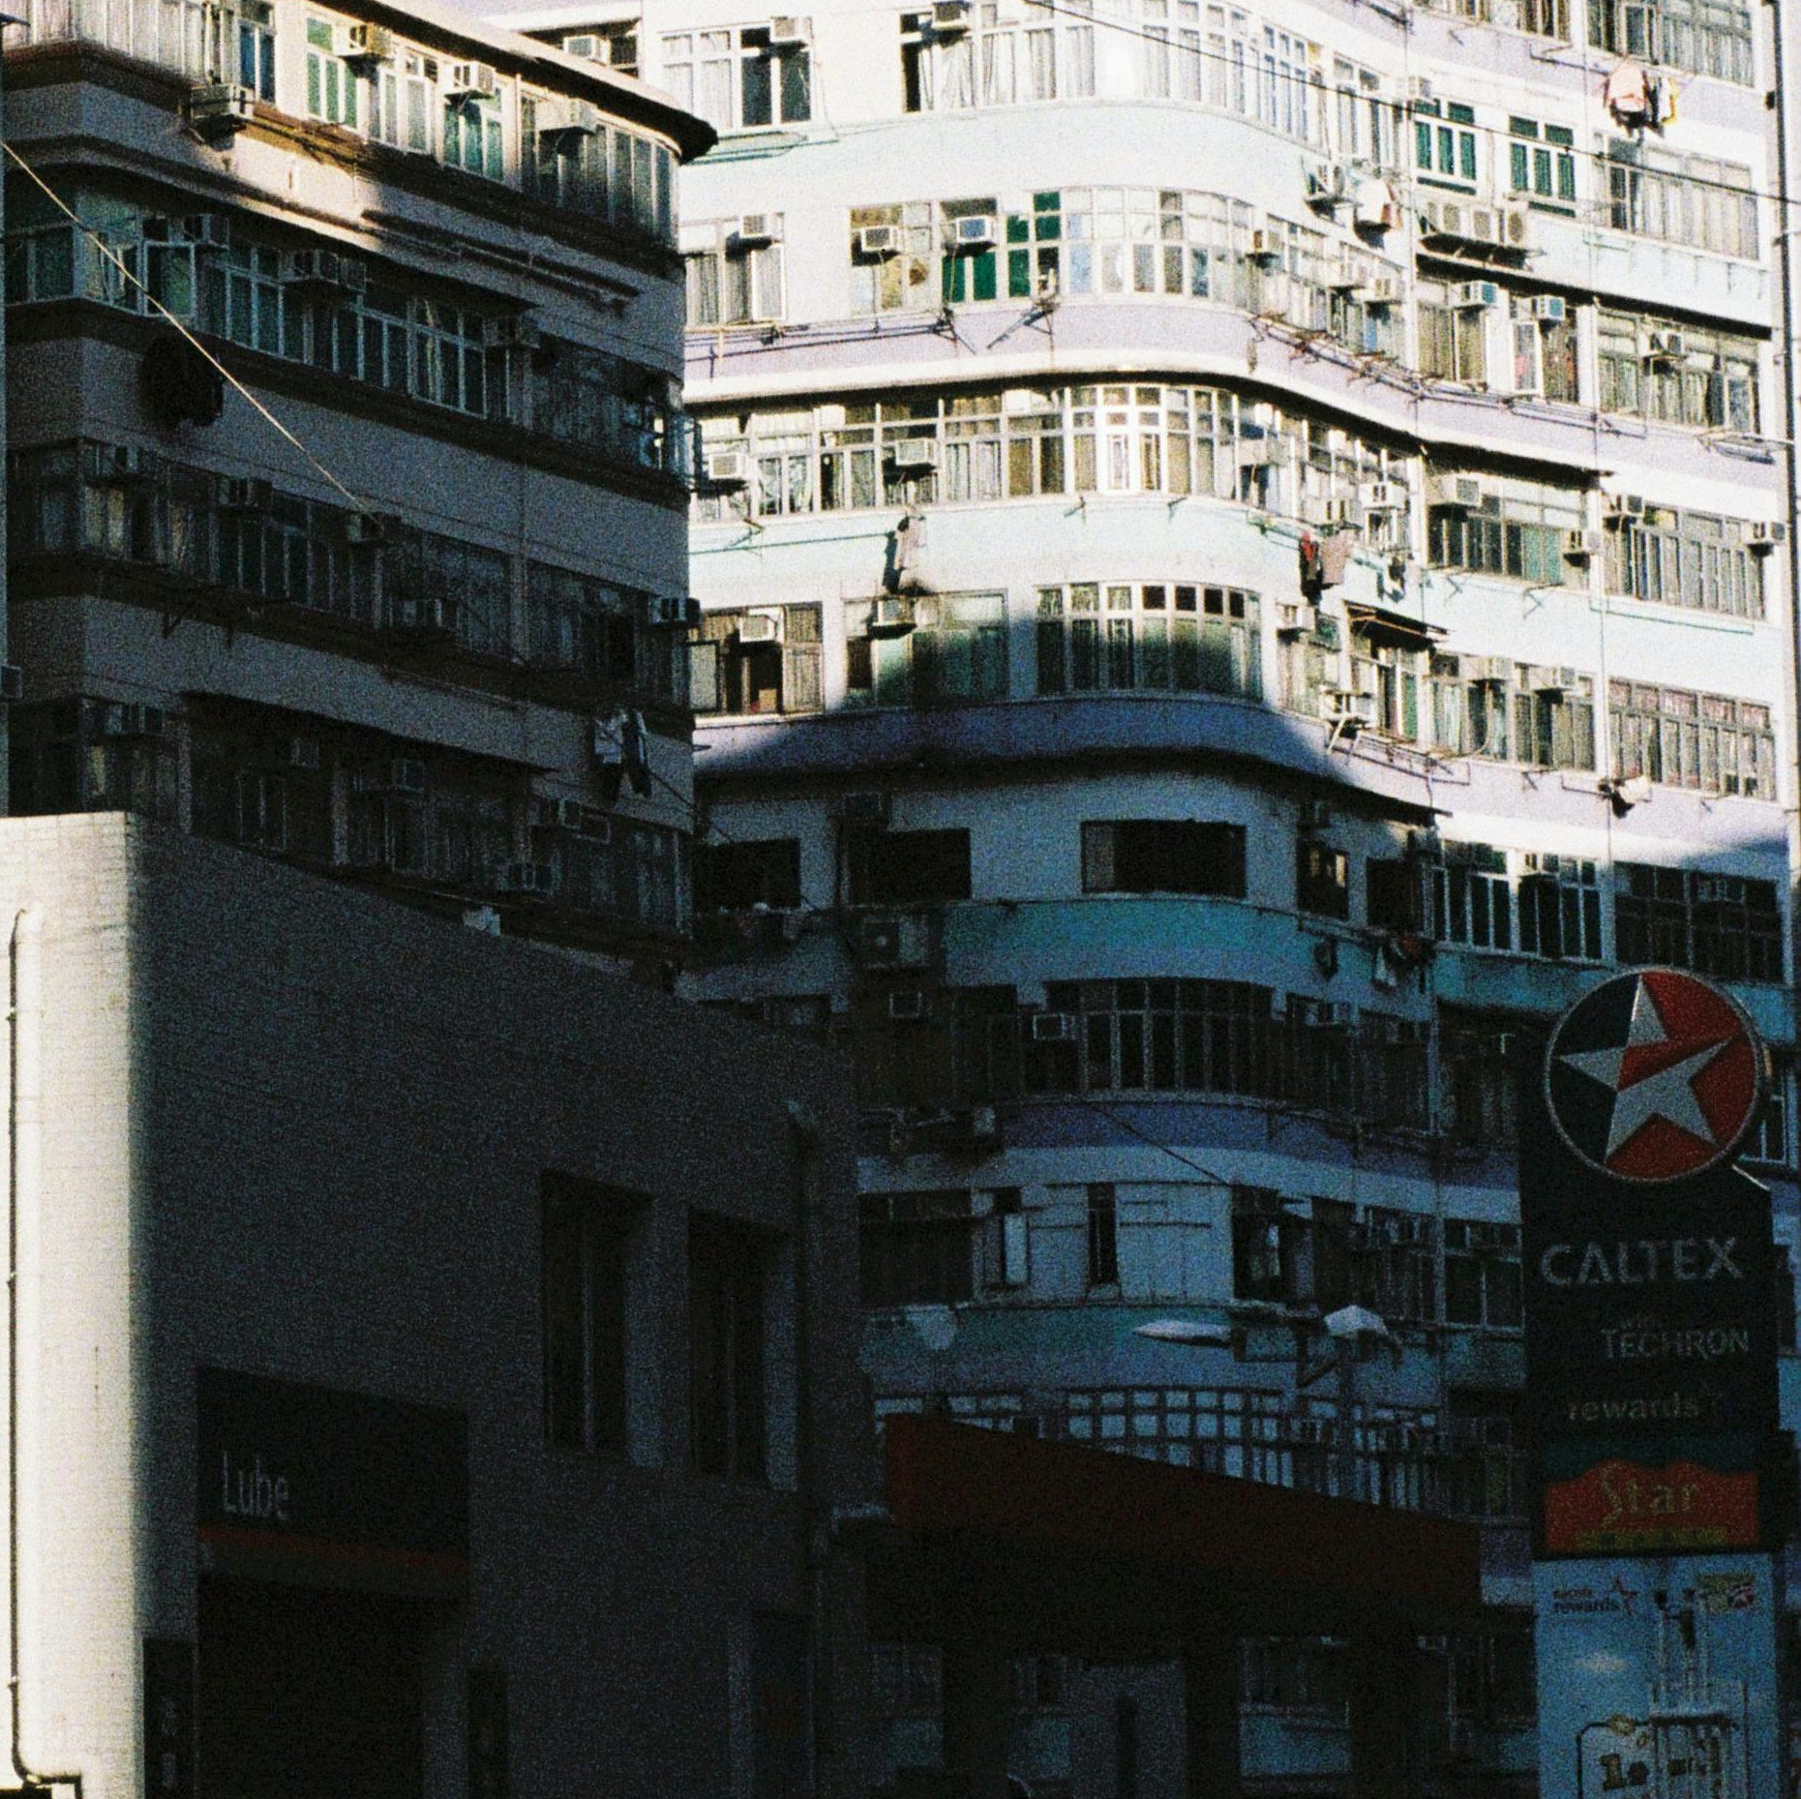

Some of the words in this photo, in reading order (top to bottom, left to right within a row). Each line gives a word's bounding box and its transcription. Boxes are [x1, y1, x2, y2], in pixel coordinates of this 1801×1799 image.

[1538, 1236, 1746, 1287] CALTEX
[1600, 1328, 1751, 1361] TECHRON
[1567, 1391, 1701, 1423] rewards
[221, 1451, 291, 1523] Lube
[1601, 1459, 1701, 1529] Star
